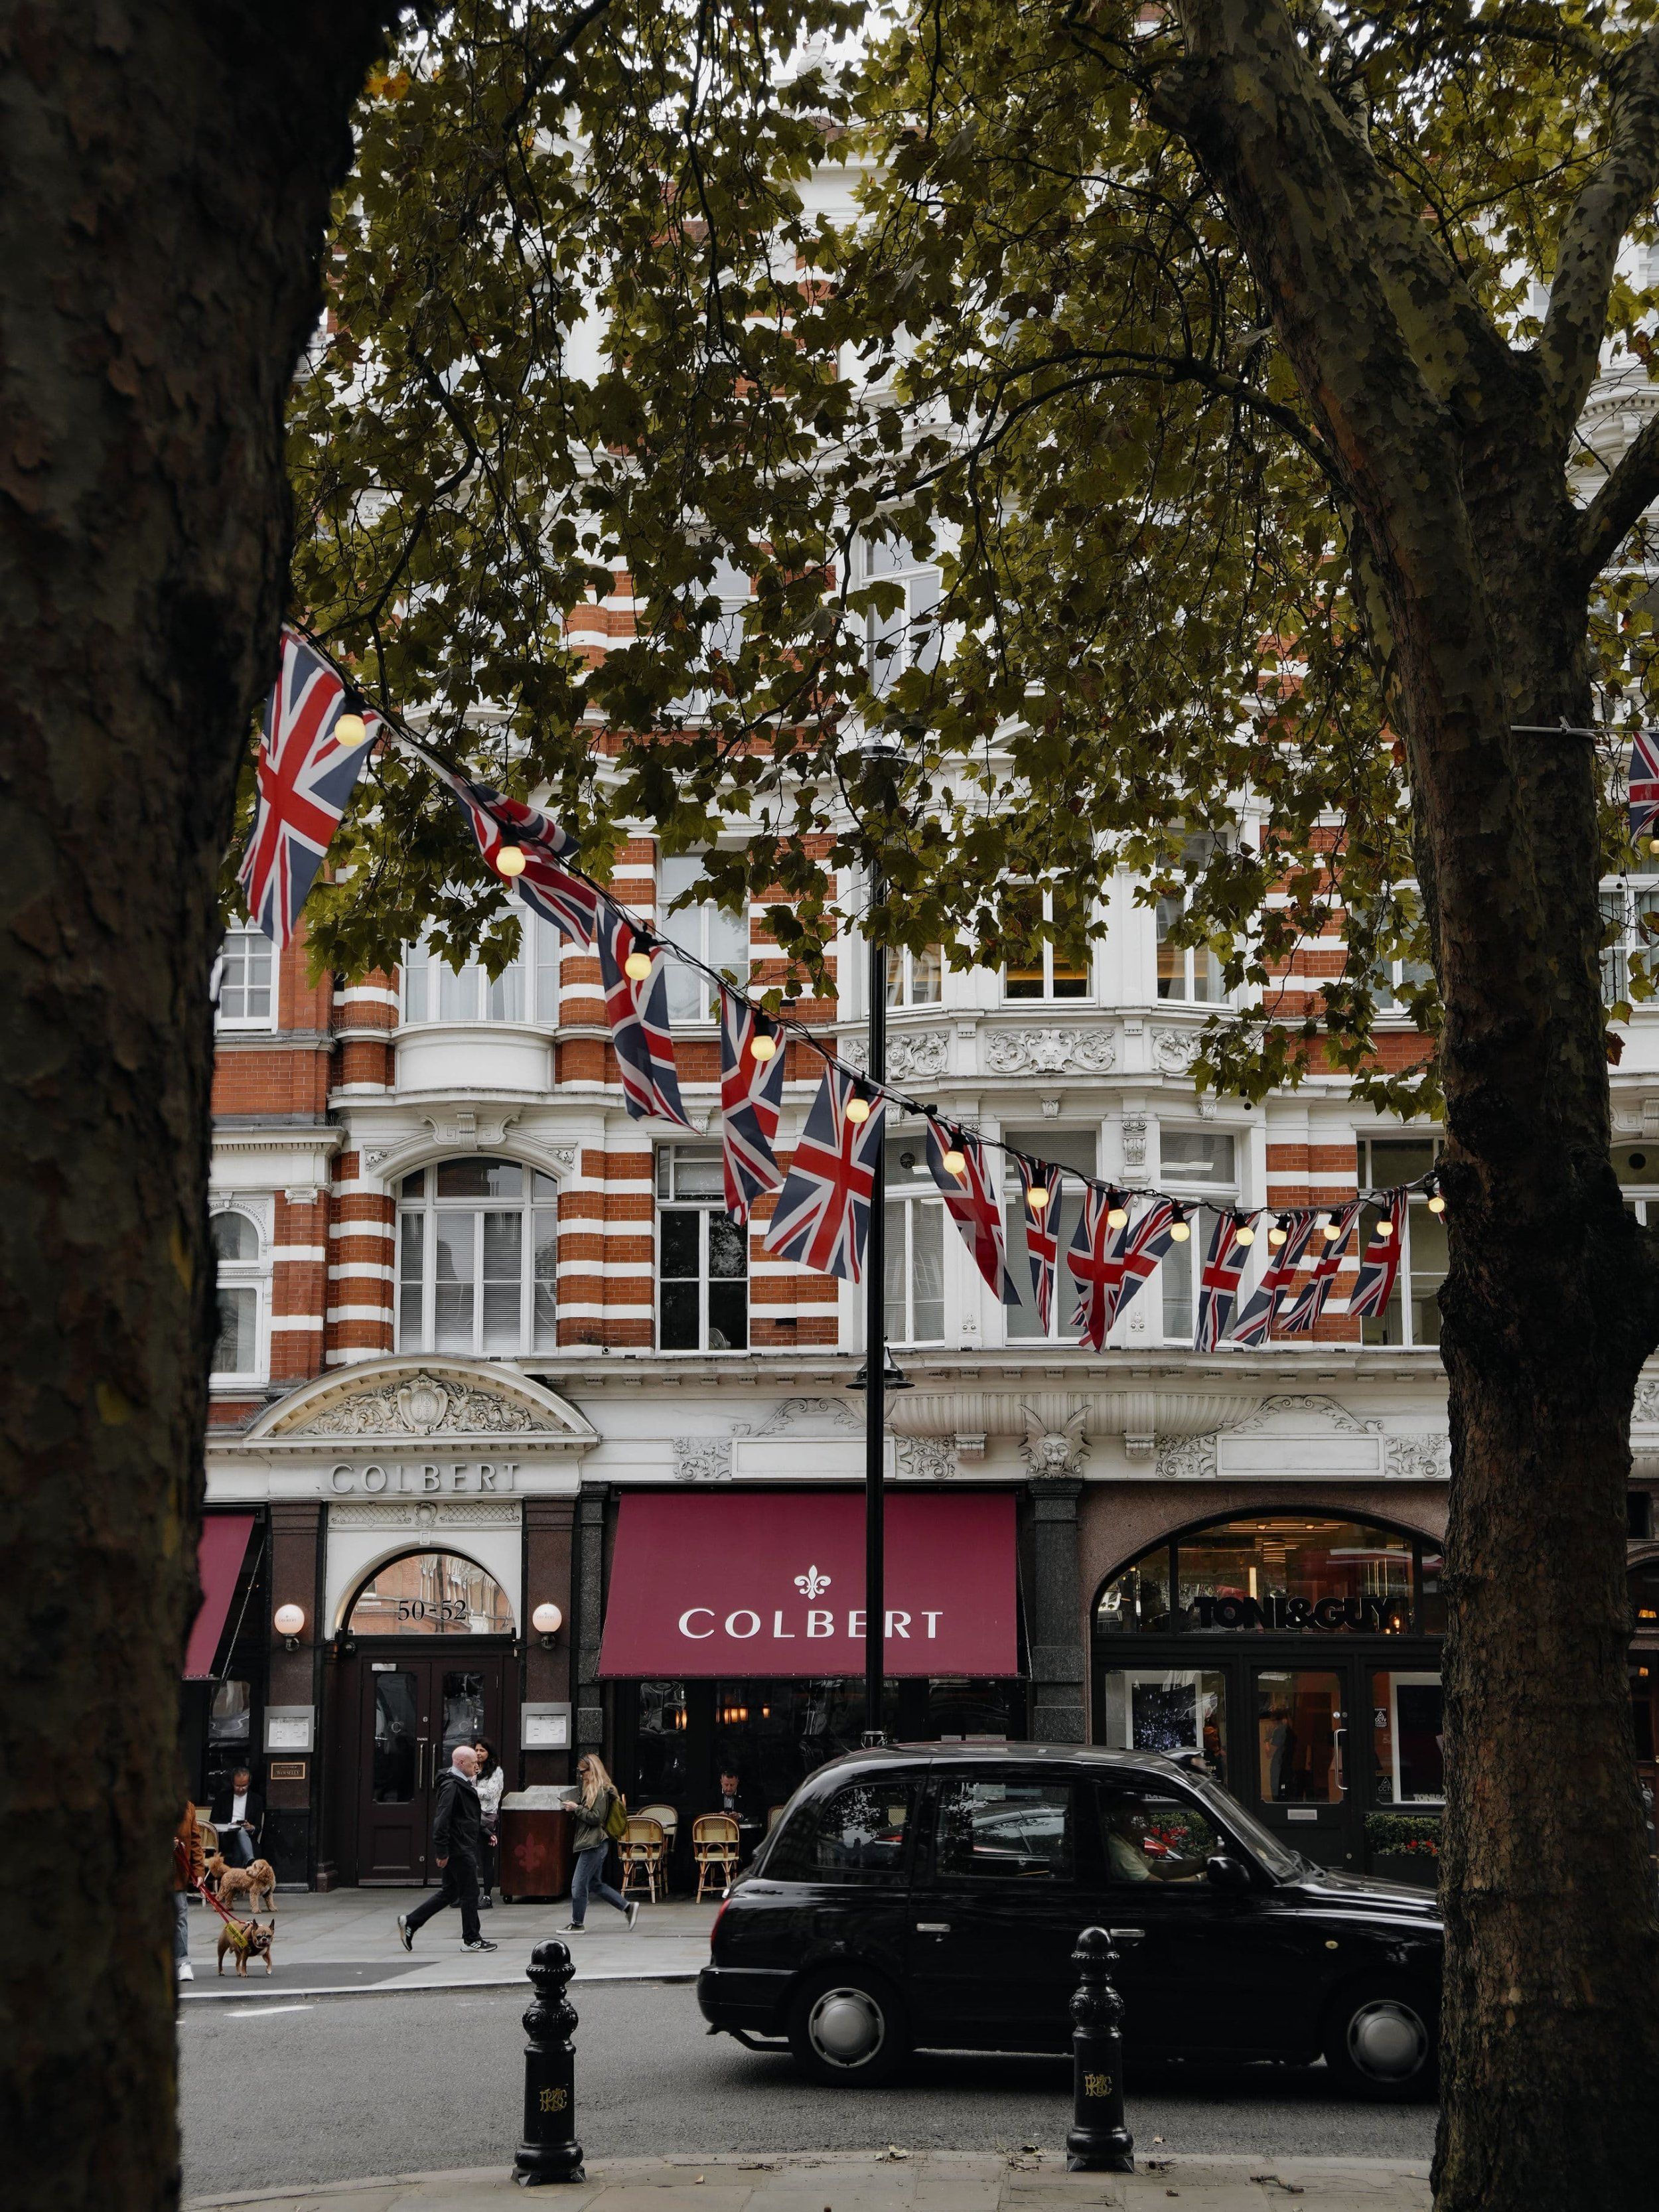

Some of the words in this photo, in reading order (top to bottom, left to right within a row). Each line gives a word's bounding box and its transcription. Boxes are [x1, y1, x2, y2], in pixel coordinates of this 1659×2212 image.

[329, 1463, 520, 1493] COLBERT
[398, 1599, 467, 1621] 50-52
[678, 1608, 944, 1639] COLBERT
[1194, 1596, 1402, 1629] TONI&GUY
